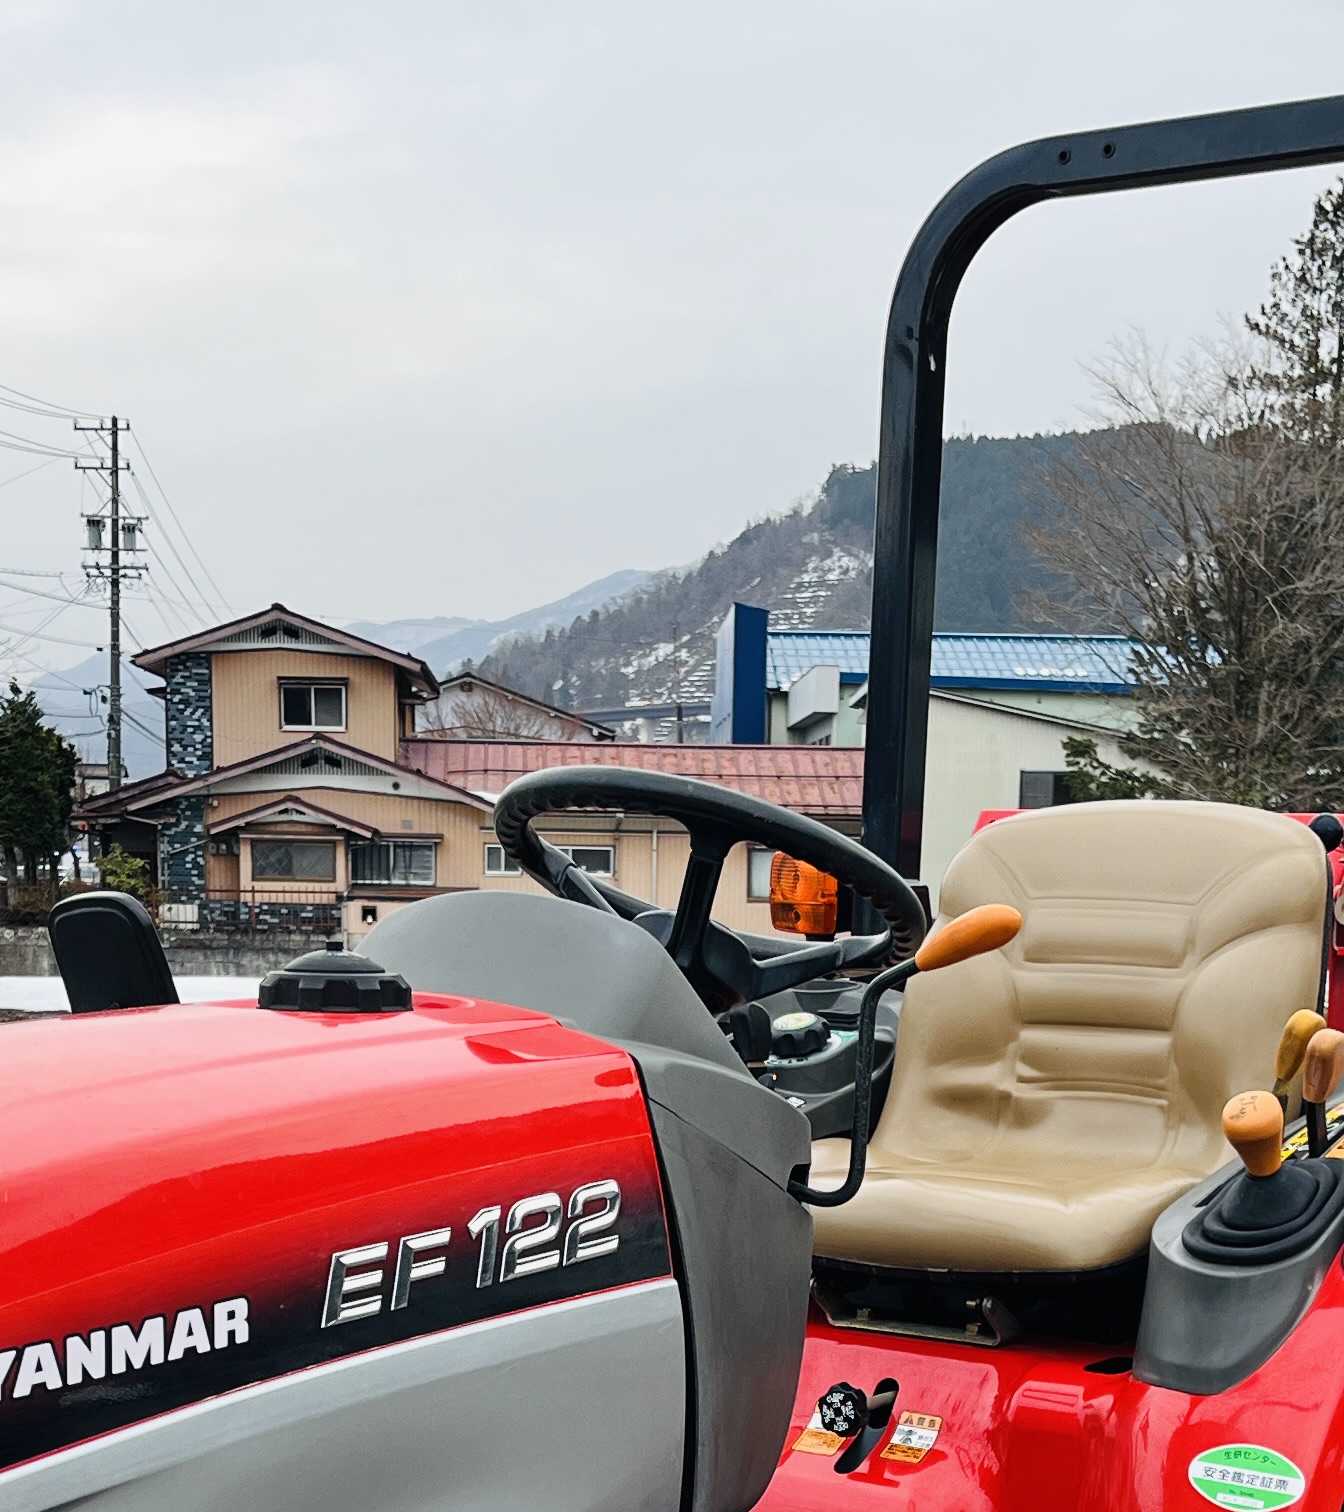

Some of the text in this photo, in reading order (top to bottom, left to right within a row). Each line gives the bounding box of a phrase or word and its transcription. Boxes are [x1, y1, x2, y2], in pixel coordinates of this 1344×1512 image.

[1224, 1450, 1277, 1465] 生研センター
[1203, 1466, 1289, 1491] 安全鑑定証票
